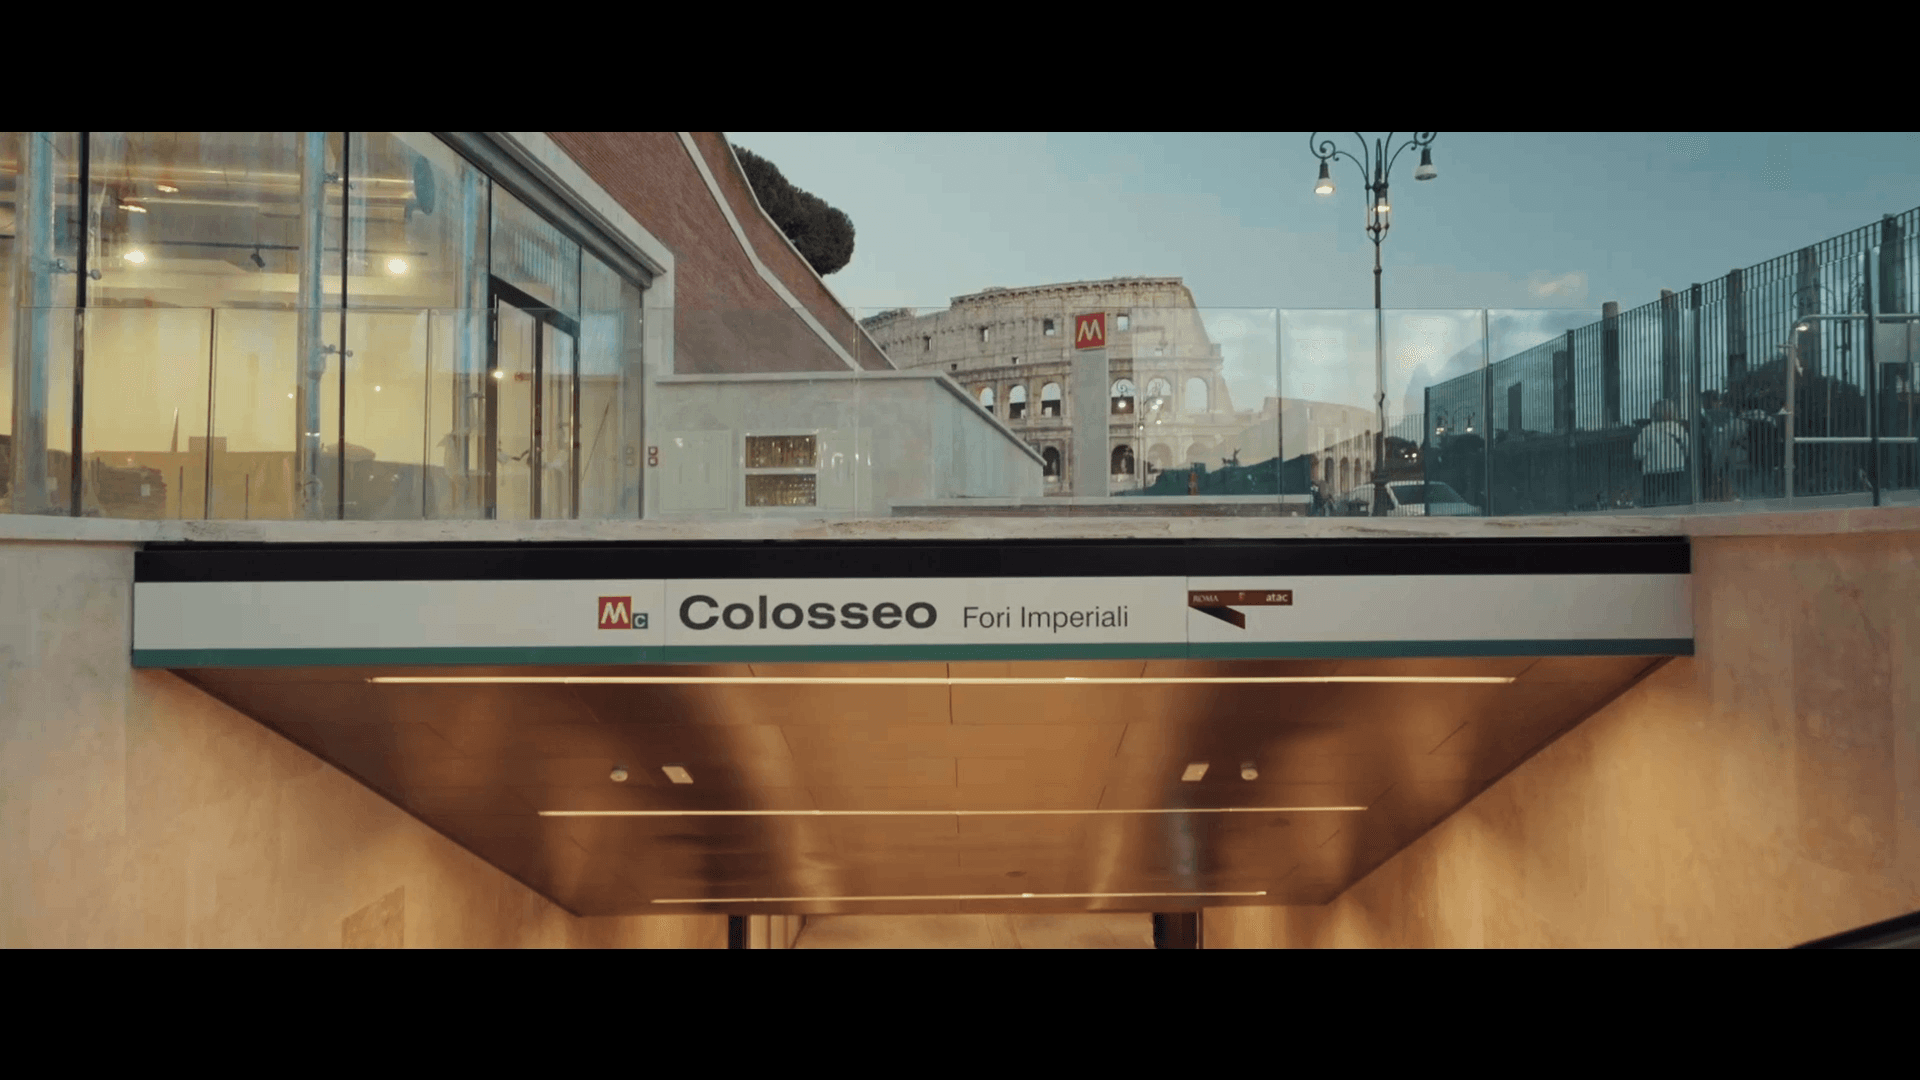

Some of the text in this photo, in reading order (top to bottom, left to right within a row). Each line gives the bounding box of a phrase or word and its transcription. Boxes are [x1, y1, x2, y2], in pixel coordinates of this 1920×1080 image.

[1077, 319, 1102, 342] M
[1192, 593, 1289, 603] ROMA atac
[600, 601, 629, 624] M
[679, 594, 1129, 634] Colosseo Fori Imperiali
